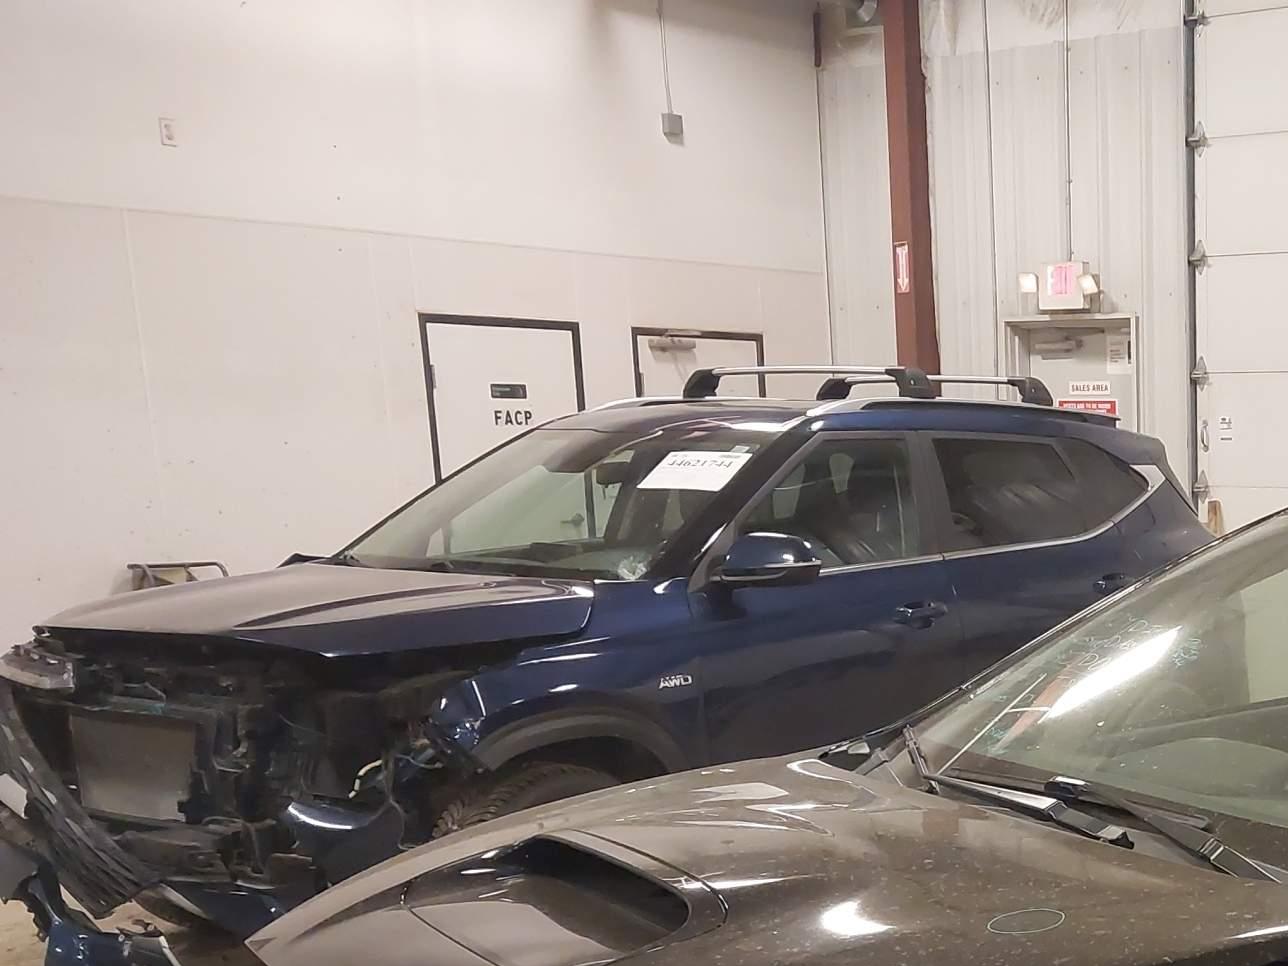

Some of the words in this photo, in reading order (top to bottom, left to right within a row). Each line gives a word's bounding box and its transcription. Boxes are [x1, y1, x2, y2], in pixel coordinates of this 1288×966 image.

[1071, 384, 1090, 392] SALES
[1092, 384, 1109, 392] AREA
[494, 410, 532, 425] FACP
[659, 674, 692, 689] AWD
